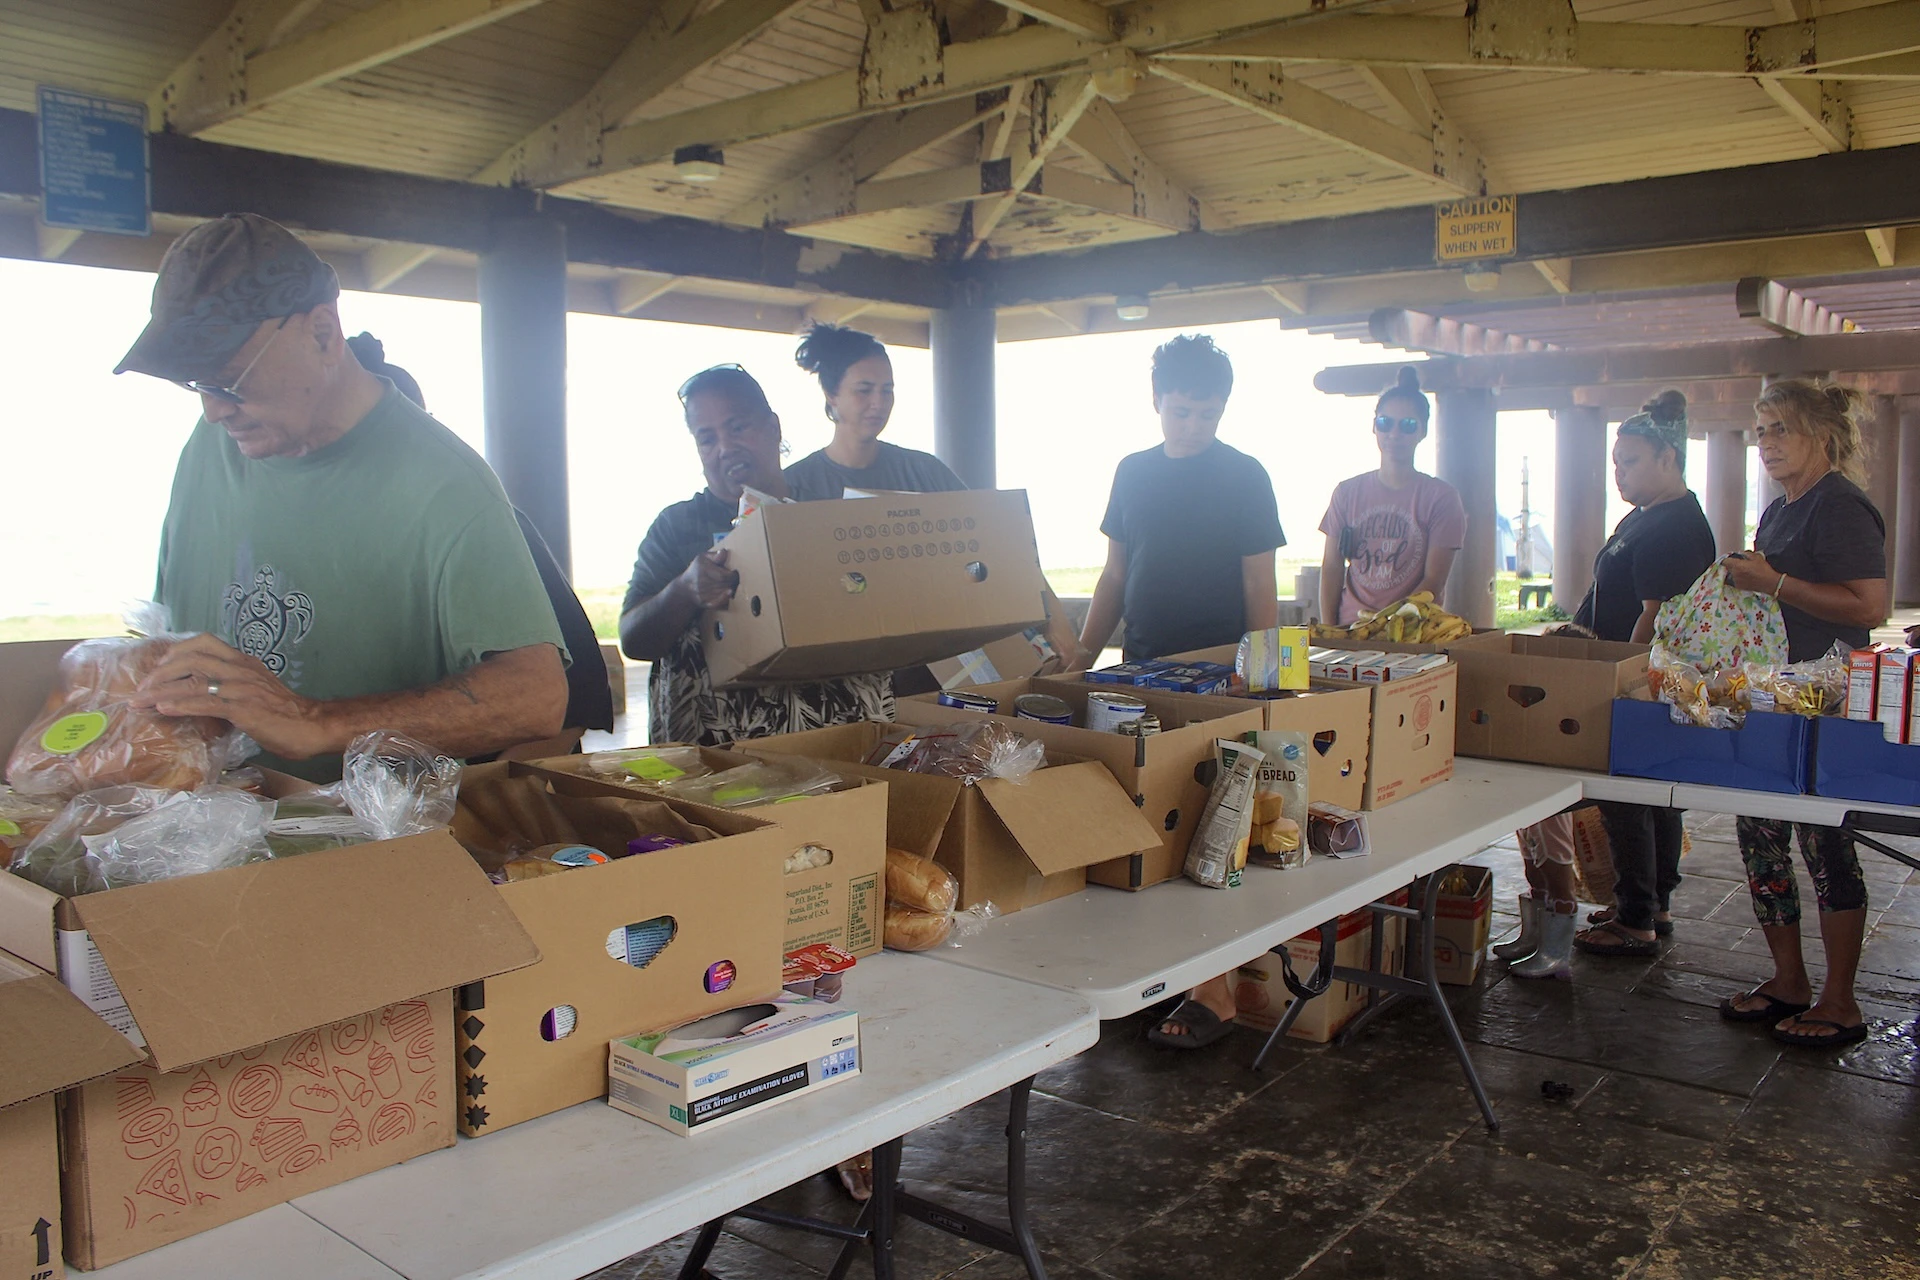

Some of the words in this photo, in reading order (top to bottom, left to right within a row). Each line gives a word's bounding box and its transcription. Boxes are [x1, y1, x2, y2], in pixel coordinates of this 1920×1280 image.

[1439, 196, 1514, 219] CAUTION
[1450, 220, 1501, 236] SLIPPERY
[1445, 241, 1477, 254] WHEN
[1483, 237, 1507, 251] WET
[887, 508, 921, 518] PACKER
[1381, 540, 1397, 553] OF
[1263, 769, 1296, 782] BREAD
[694, 1103, 712, 1115] BLACK
[713, 1093, 738, 1109] NITRILE
[738, 1079, 781, 1099] EXAMINATION
[781, 1070, 805, 1086] GLOVES
[670, 1107, 680, 1119] XL
